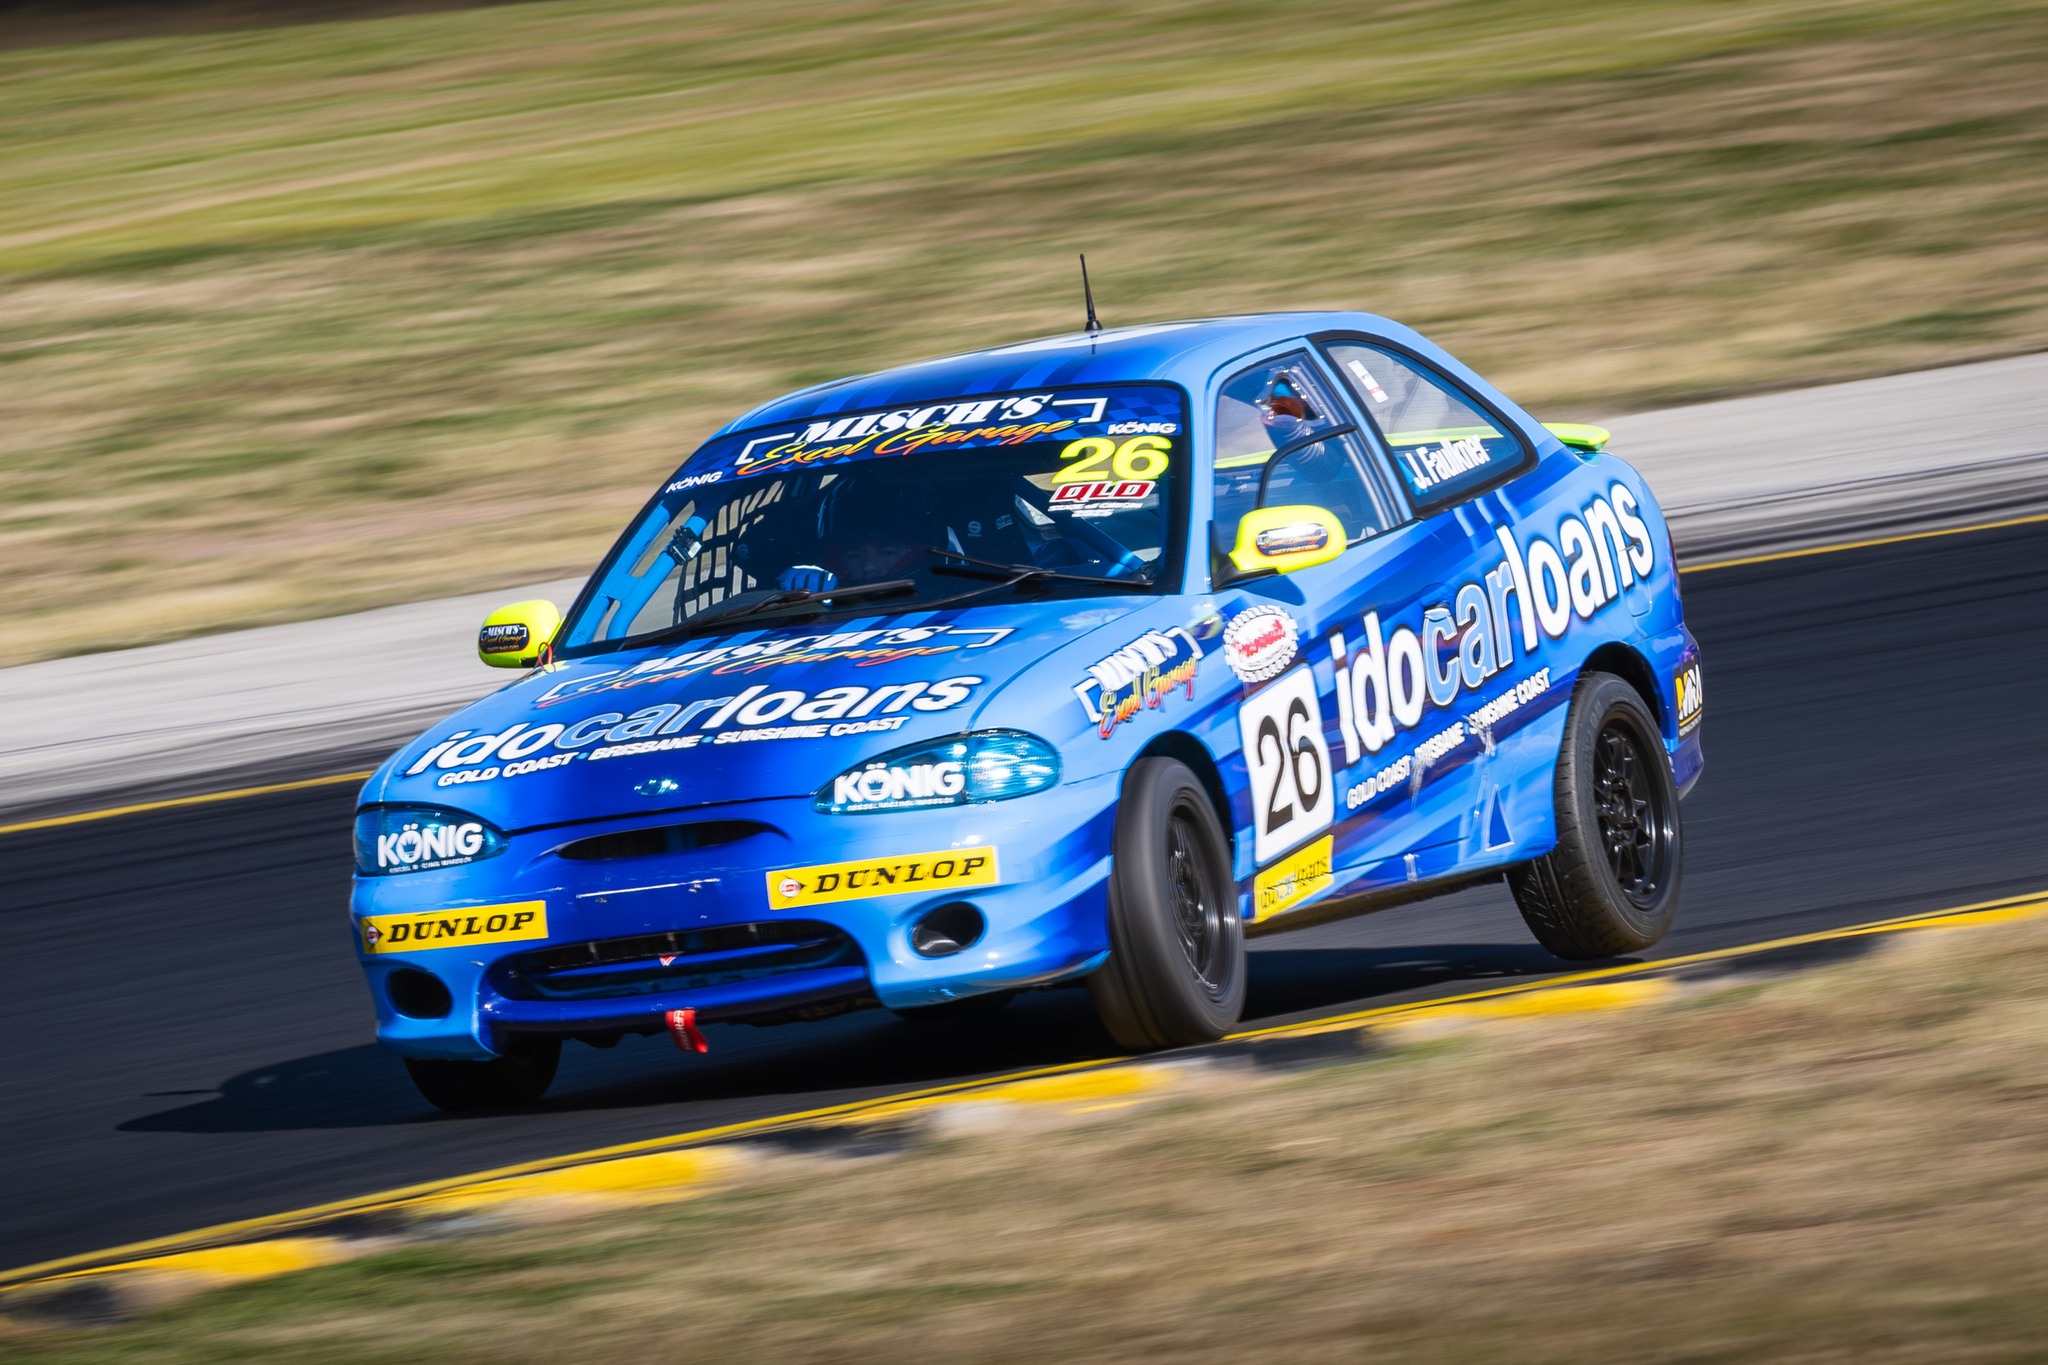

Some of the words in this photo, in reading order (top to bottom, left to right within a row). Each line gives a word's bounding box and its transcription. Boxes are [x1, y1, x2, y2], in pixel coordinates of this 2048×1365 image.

[793, 394, 1055, 446] MISCH'S
[1107, 421, 1177, 435] KÖNIG
[737, 432, 884, 476] Excel
[873, 420, 1075, 456] Garage
[1051, 435, 1173, 484] 26
[666, 471, 723, 493] KÖNIG
[1049, 480, 1156, 502] QLD
[617, 625, 953, 678] MISCH'S
[1516, 667, 1551, 705] COAST
[404, 676, 983, 776] idocarloans
[438, 766, 501, 787] GOLD
[502, 751, 580, 778] COAST
[587, 734, 704, 761] BRISBANE
[713, 724, 828, 744] SUNSHINE
[829, 716, 911, 736] COAST
[1258, 697, 1321, 835] 26
[834, 762, 965, 805] KÖNIG
[377, 822, 483, 868] KÖNIG
[813, 856, 986, 894] DUNLOP
[387, 911, 535, 943] DUNLOP
